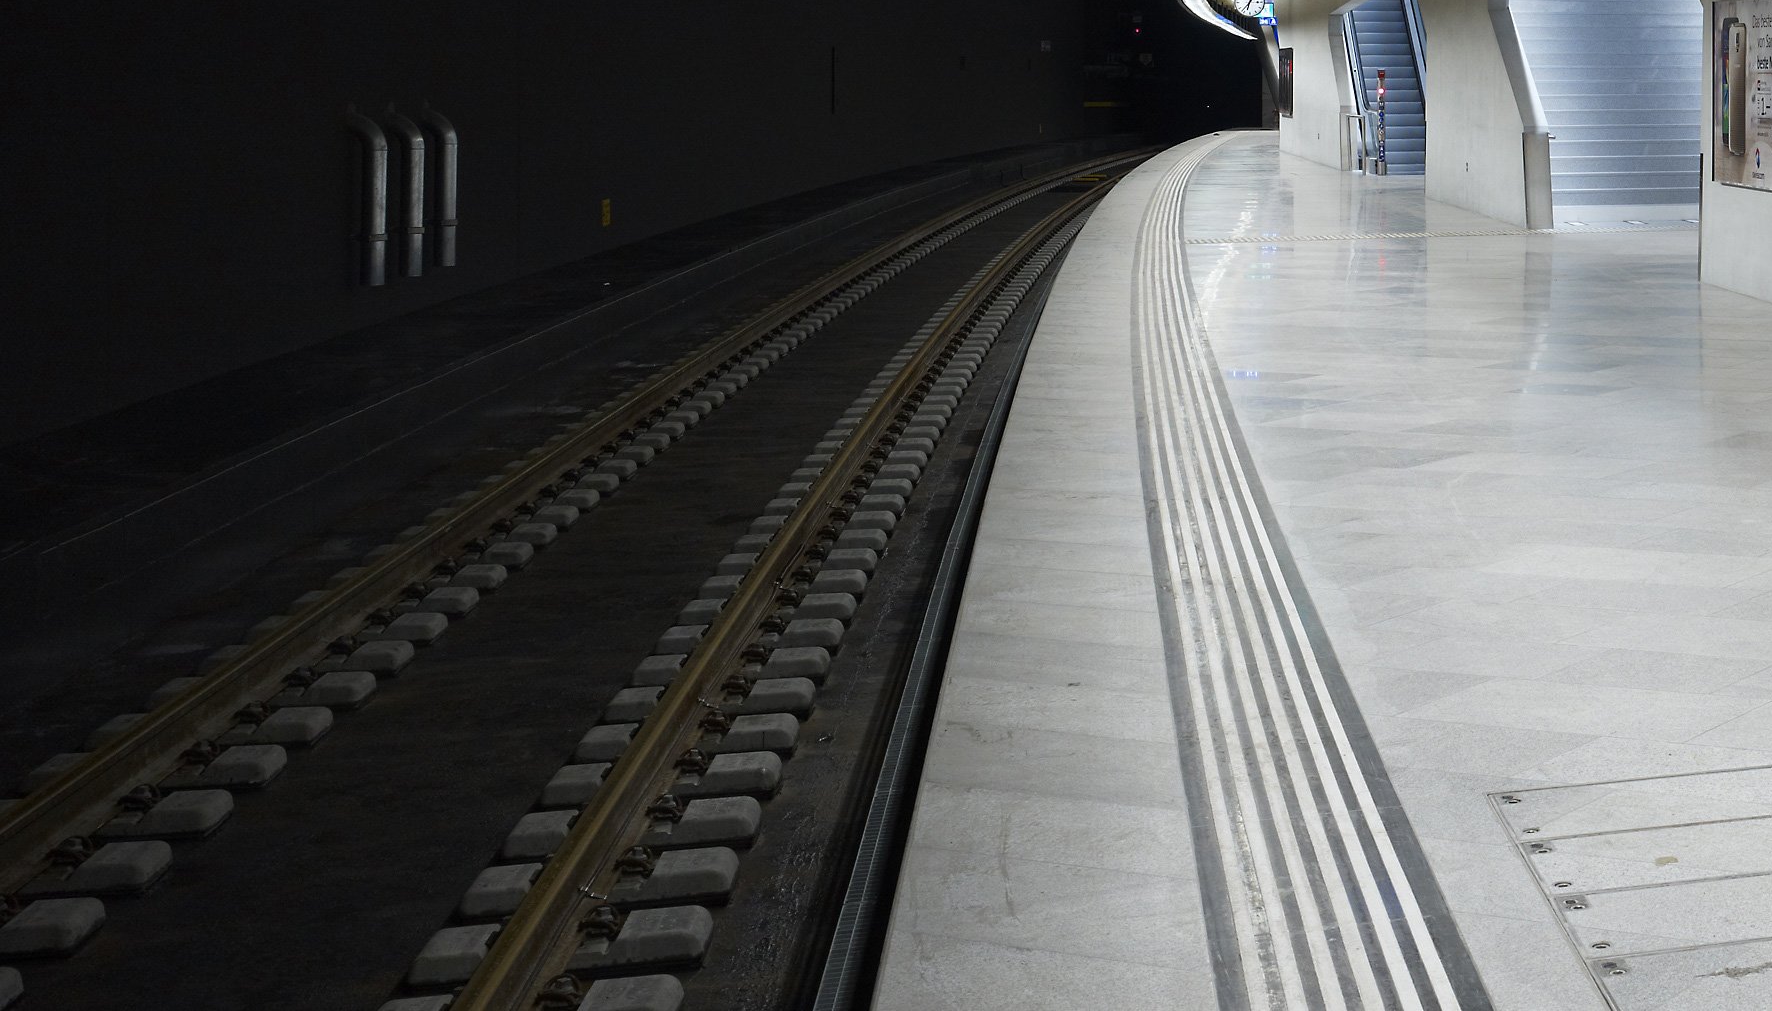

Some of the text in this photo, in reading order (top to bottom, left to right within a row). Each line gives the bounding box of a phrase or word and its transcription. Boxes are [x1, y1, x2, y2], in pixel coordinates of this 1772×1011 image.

[1752, 15, 1760, 28] Das
[1761, 14, 1772, 28] beste
[1757, 55, 1769, 70] beste
